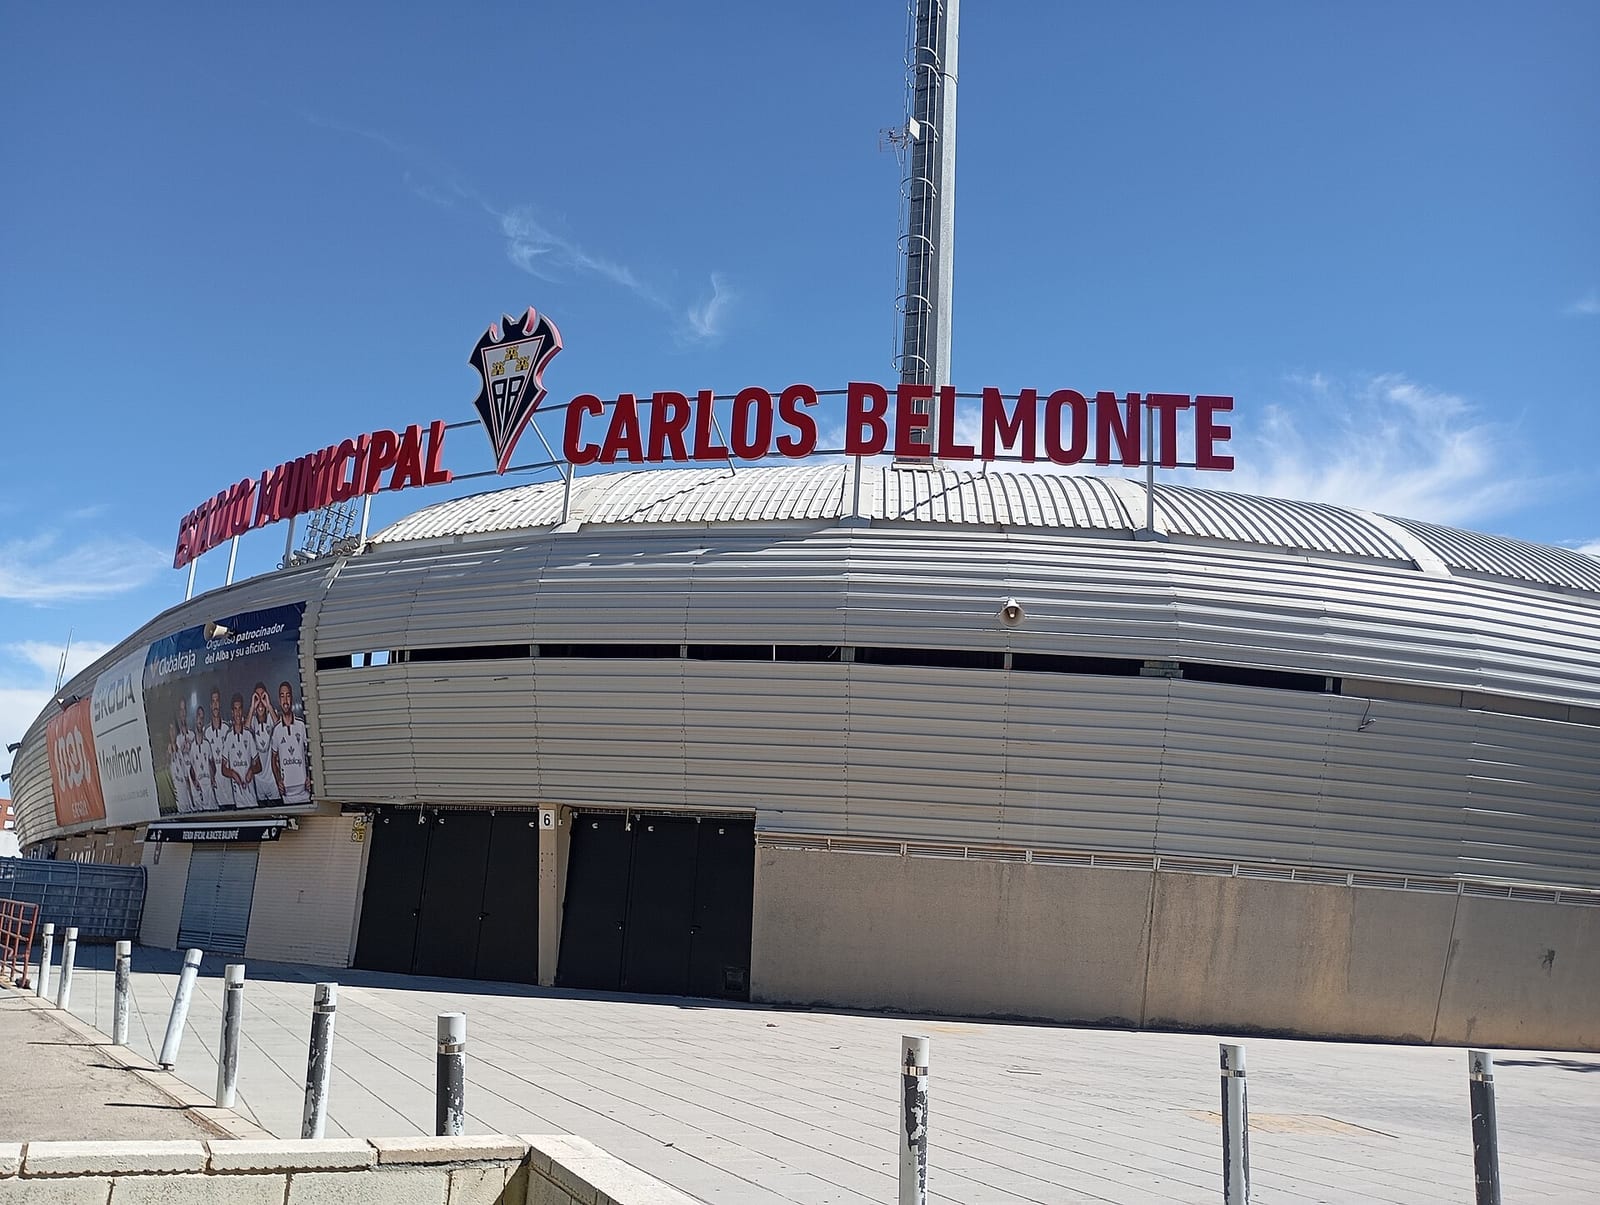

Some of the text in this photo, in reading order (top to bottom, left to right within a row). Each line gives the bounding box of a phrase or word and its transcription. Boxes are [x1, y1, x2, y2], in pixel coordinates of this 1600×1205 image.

[563, 381, 1236, 471] CARLOS BELMONTE
[173, 419, 453, 569] ESTADIO MUNICIPAL
[236, 624, 285, 644] patrocinador
[159, 649, 196, 675] Globalcaja
[205, 652, 215, 665] del
[215, 649, 229, 661] Alba
[229, 649, 236, 661] y
[236, 648, 245, 658] su
[543, 813, 551, 826] 6
